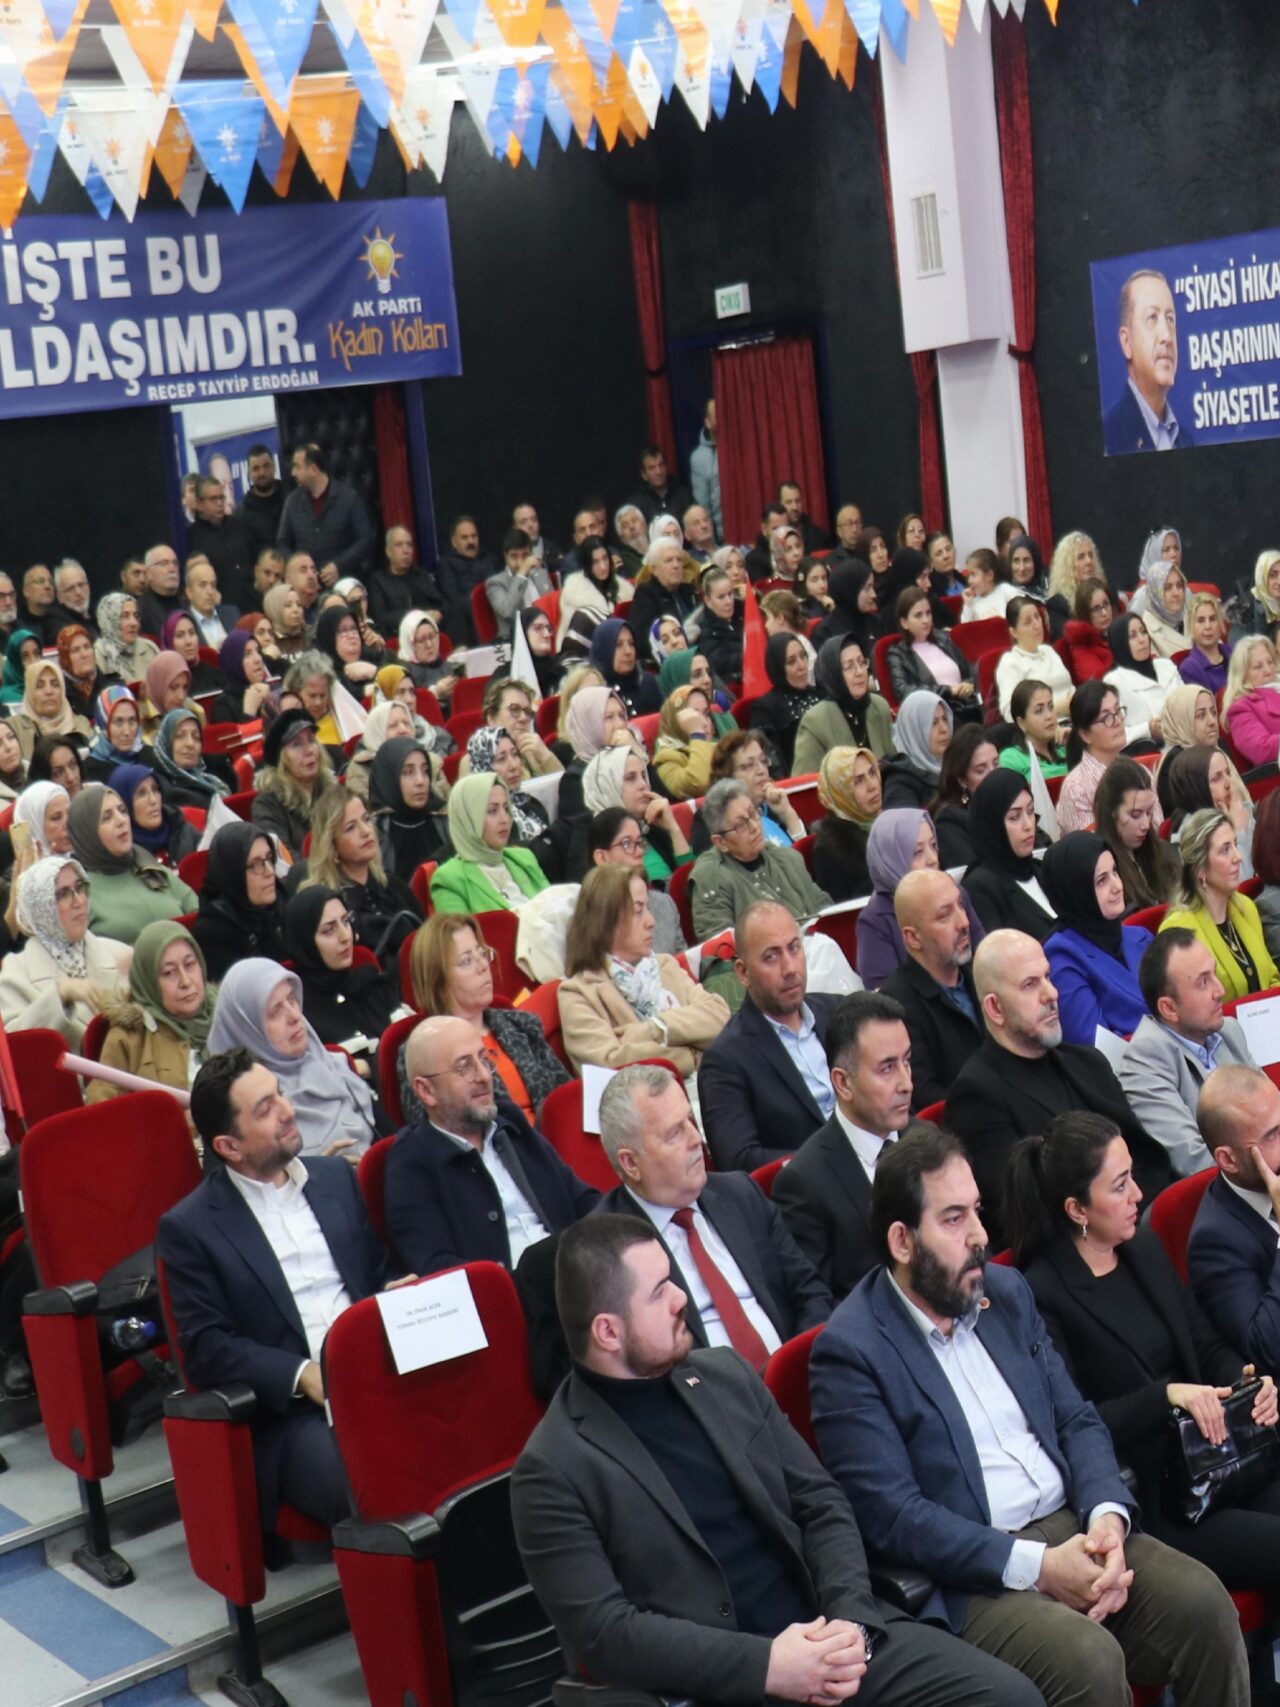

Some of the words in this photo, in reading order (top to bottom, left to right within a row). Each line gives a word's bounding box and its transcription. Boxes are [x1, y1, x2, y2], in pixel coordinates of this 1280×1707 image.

[2, 228, 132, 321] İŞTE
[145, 234, 222, 296] BU
[353, 302, 375, 317] AK
[379, 296, 422, 315] PARTİ
[328, 320, 383, 372] Kadın
[391, 318, 448, 355] Kolları
[1188, 324, 1280, 378] BAŞARININ
[148, 383, 196, 401] RECEP
[199, 374, 249, 396] TAYYİP
[253, 369, 319, 390] ERDOĞAN
[1193, 381, 1280, 429] SİYASETLE
